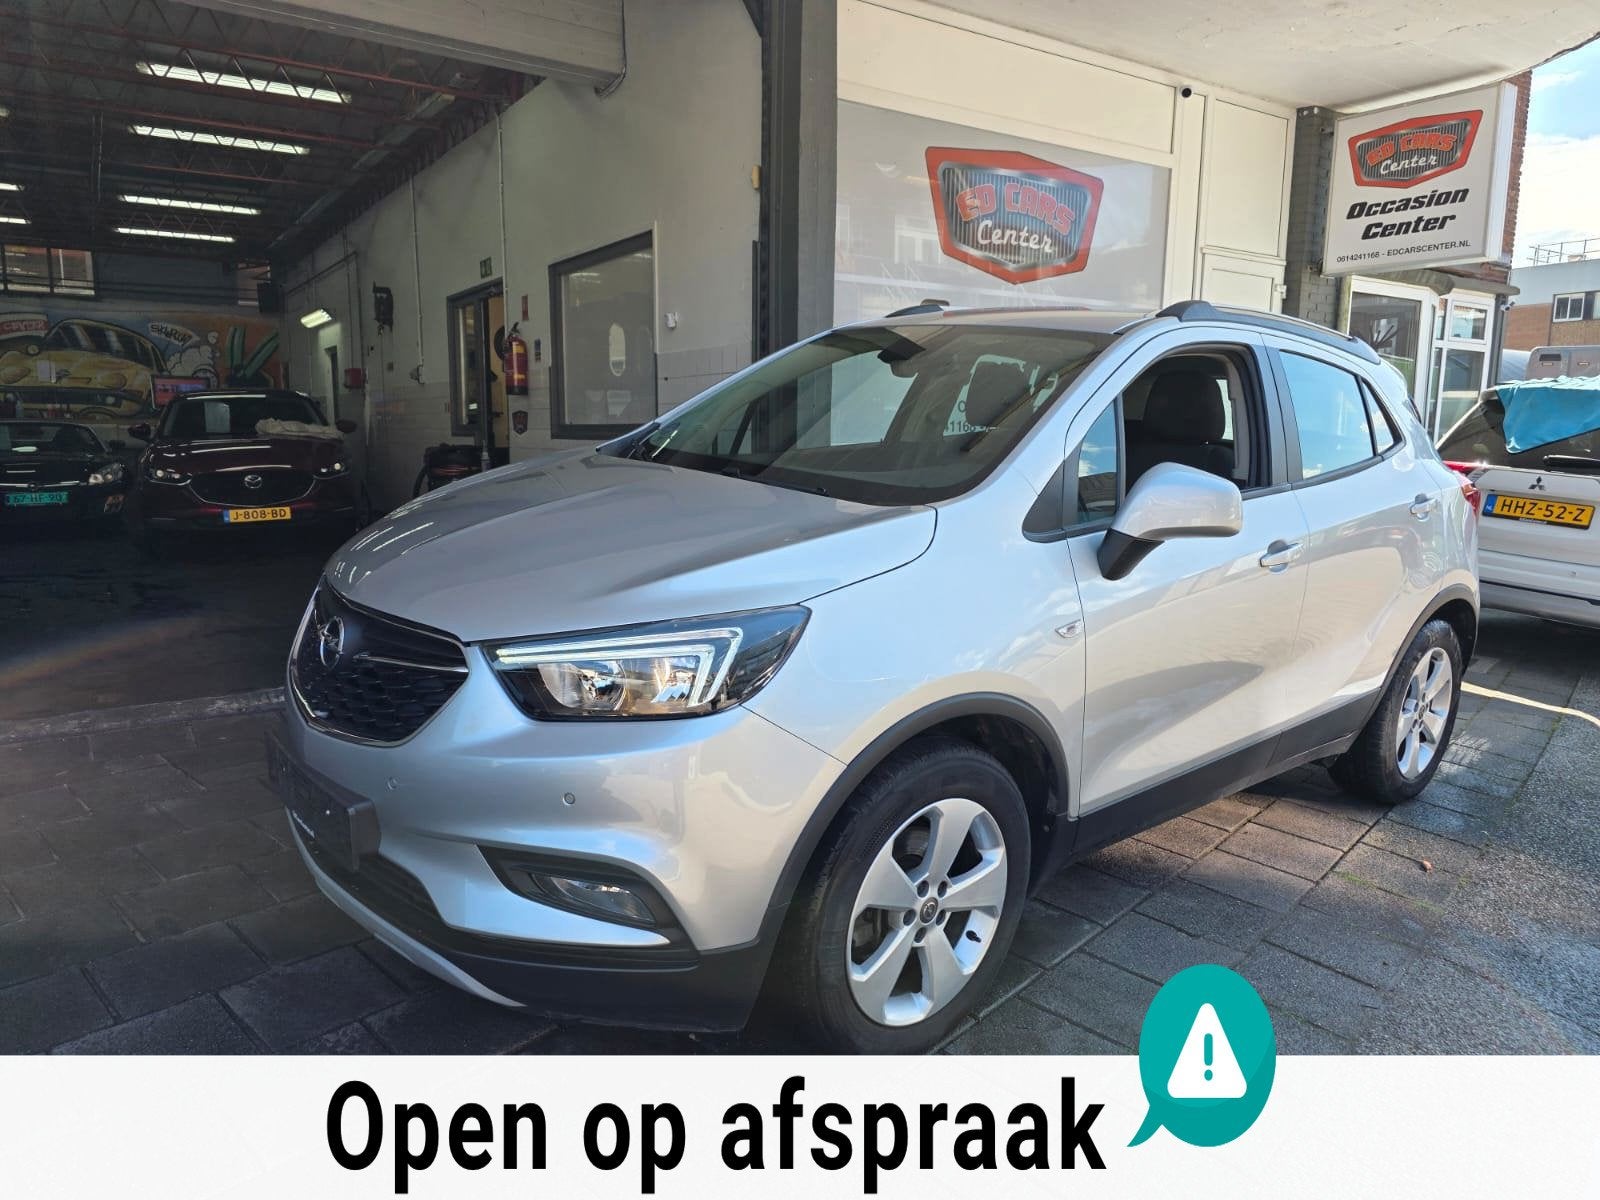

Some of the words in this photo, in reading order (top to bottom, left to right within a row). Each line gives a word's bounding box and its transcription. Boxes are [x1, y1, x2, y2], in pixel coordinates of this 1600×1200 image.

[1400, 133, 1457, 152] CARS
[1380, 155, 1438, 174] Center
[956, 183, 997, 222] ED
[1004, 183, 1075, 236] CARS
[1346, 188, 1470, 220] Occasion
[977, 219, 1056, 253] Center
[1361, 214, 1457, 240] Center
[1336, 251, 1380, 263] 0614241168
[1387, 240, 1471, 257] EDCARSCENTER.NL
[232, 508, 287, 520] J-808-BD
[1500, 498, 1586, 522] HHZ-52-Z
